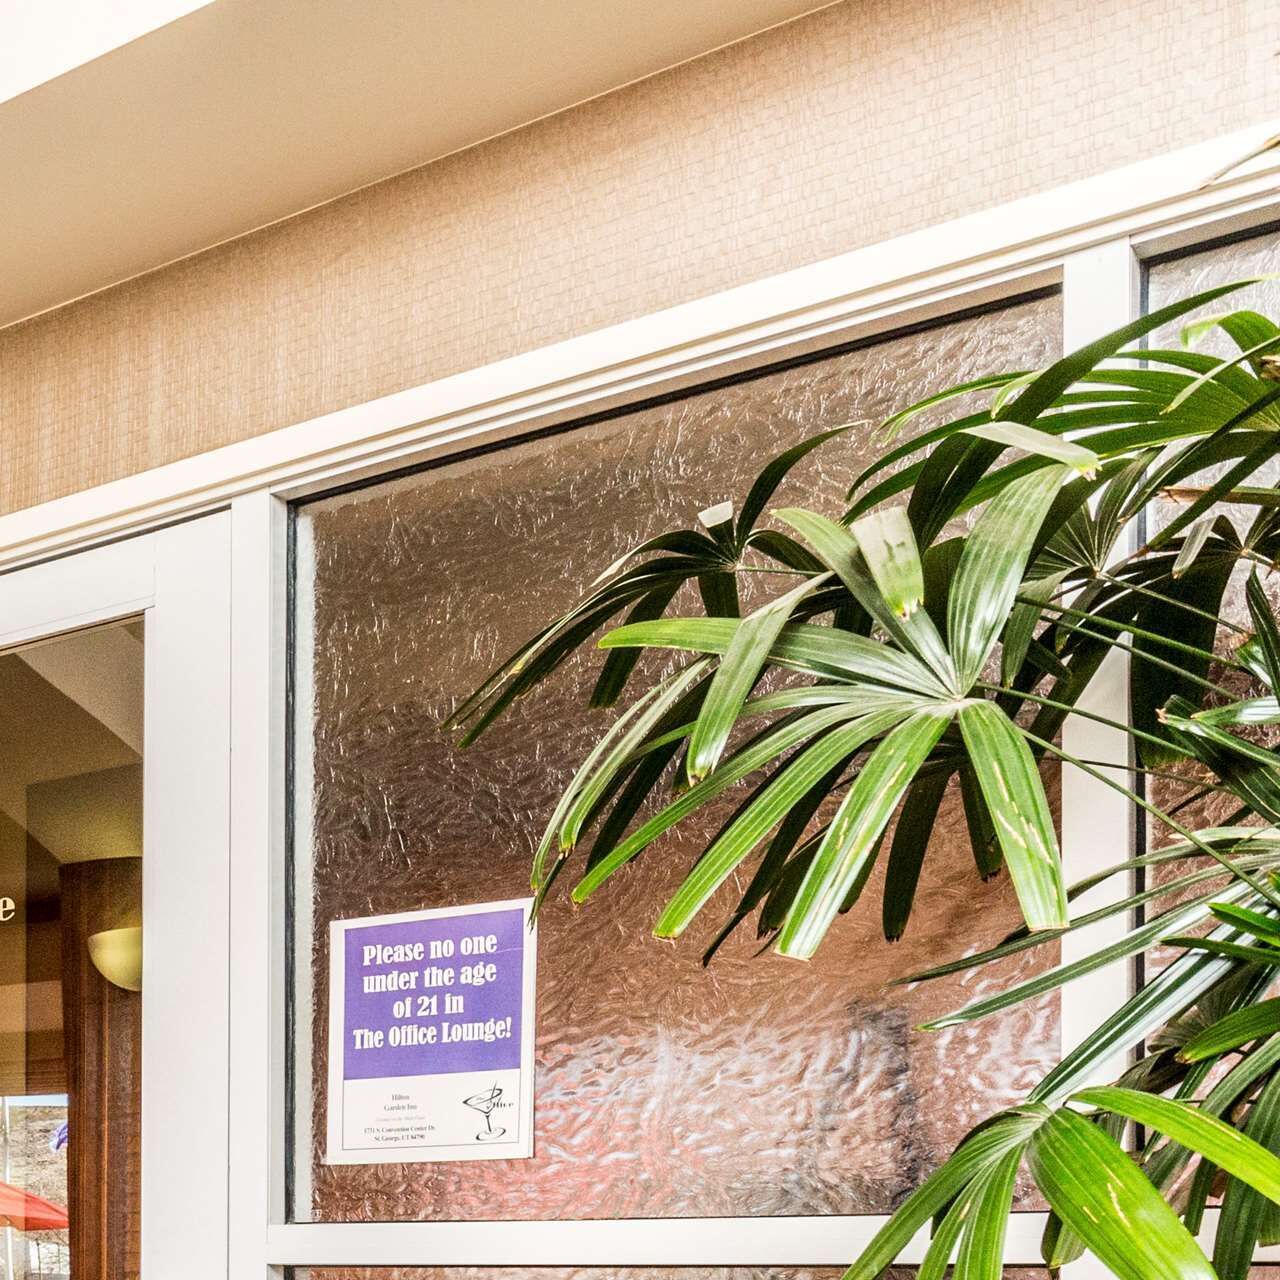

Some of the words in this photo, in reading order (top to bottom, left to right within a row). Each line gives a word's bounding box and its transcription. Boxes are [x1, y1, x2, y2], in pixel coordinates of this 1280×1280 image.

[362, 942, 425, 967] Please
[429, 938, 455, 959] no
[460, 934, 498, 956] one
[362, 971, 419, 994] under
[424, 966, 455, 989] the
[460, 962, 497, 986] age
[393, 997, 413, 1019] of
[417, 995, 439, 1017] 21
[444, 993, 464, 1015] in
[353, 1028, 384, 1049] The
[388, 1025, 438, 1048] Office
[441, 1017, 512, 1044] Lounge!
